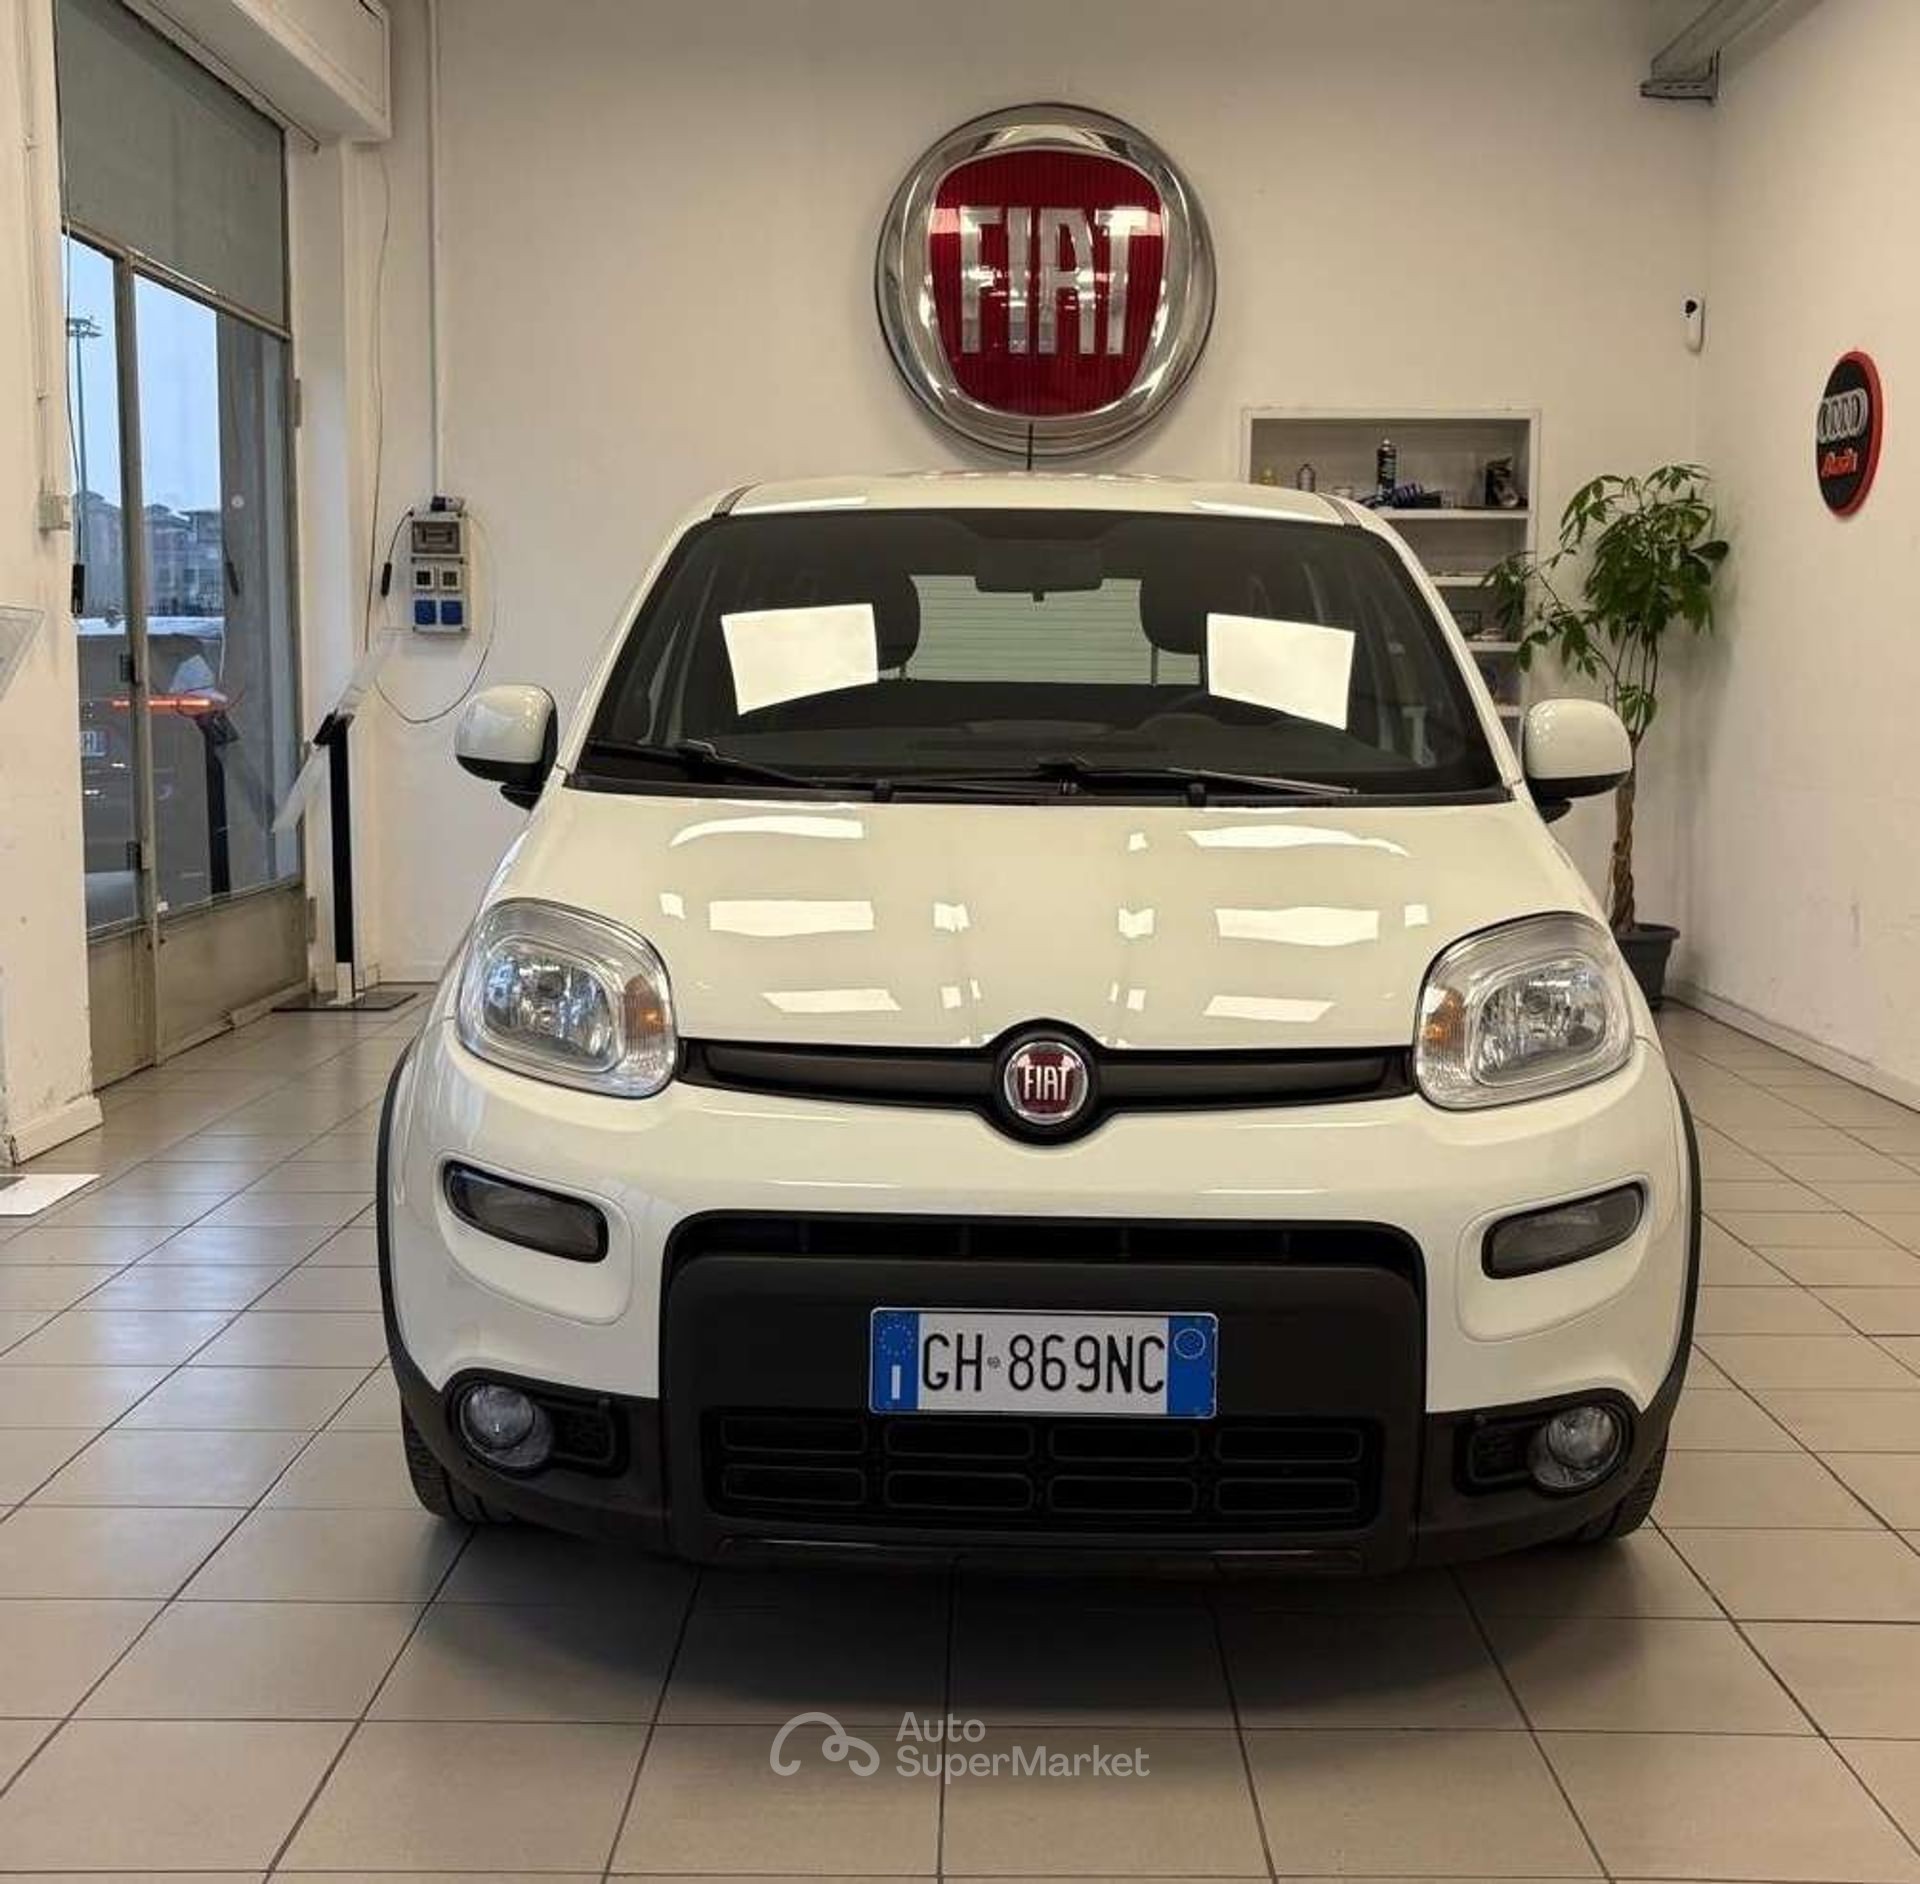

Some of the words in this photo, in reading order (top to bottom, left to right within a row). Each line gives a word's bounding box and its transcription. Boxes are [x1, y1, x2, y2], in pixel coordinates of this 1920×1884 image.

[960, 205, 1149, 354] FIAT
[1024, 1065, 1071, 1100] FIAT
[922, 1334, 983, 1391] GH
[1008, 1334, 1165, 1394] 869NC
